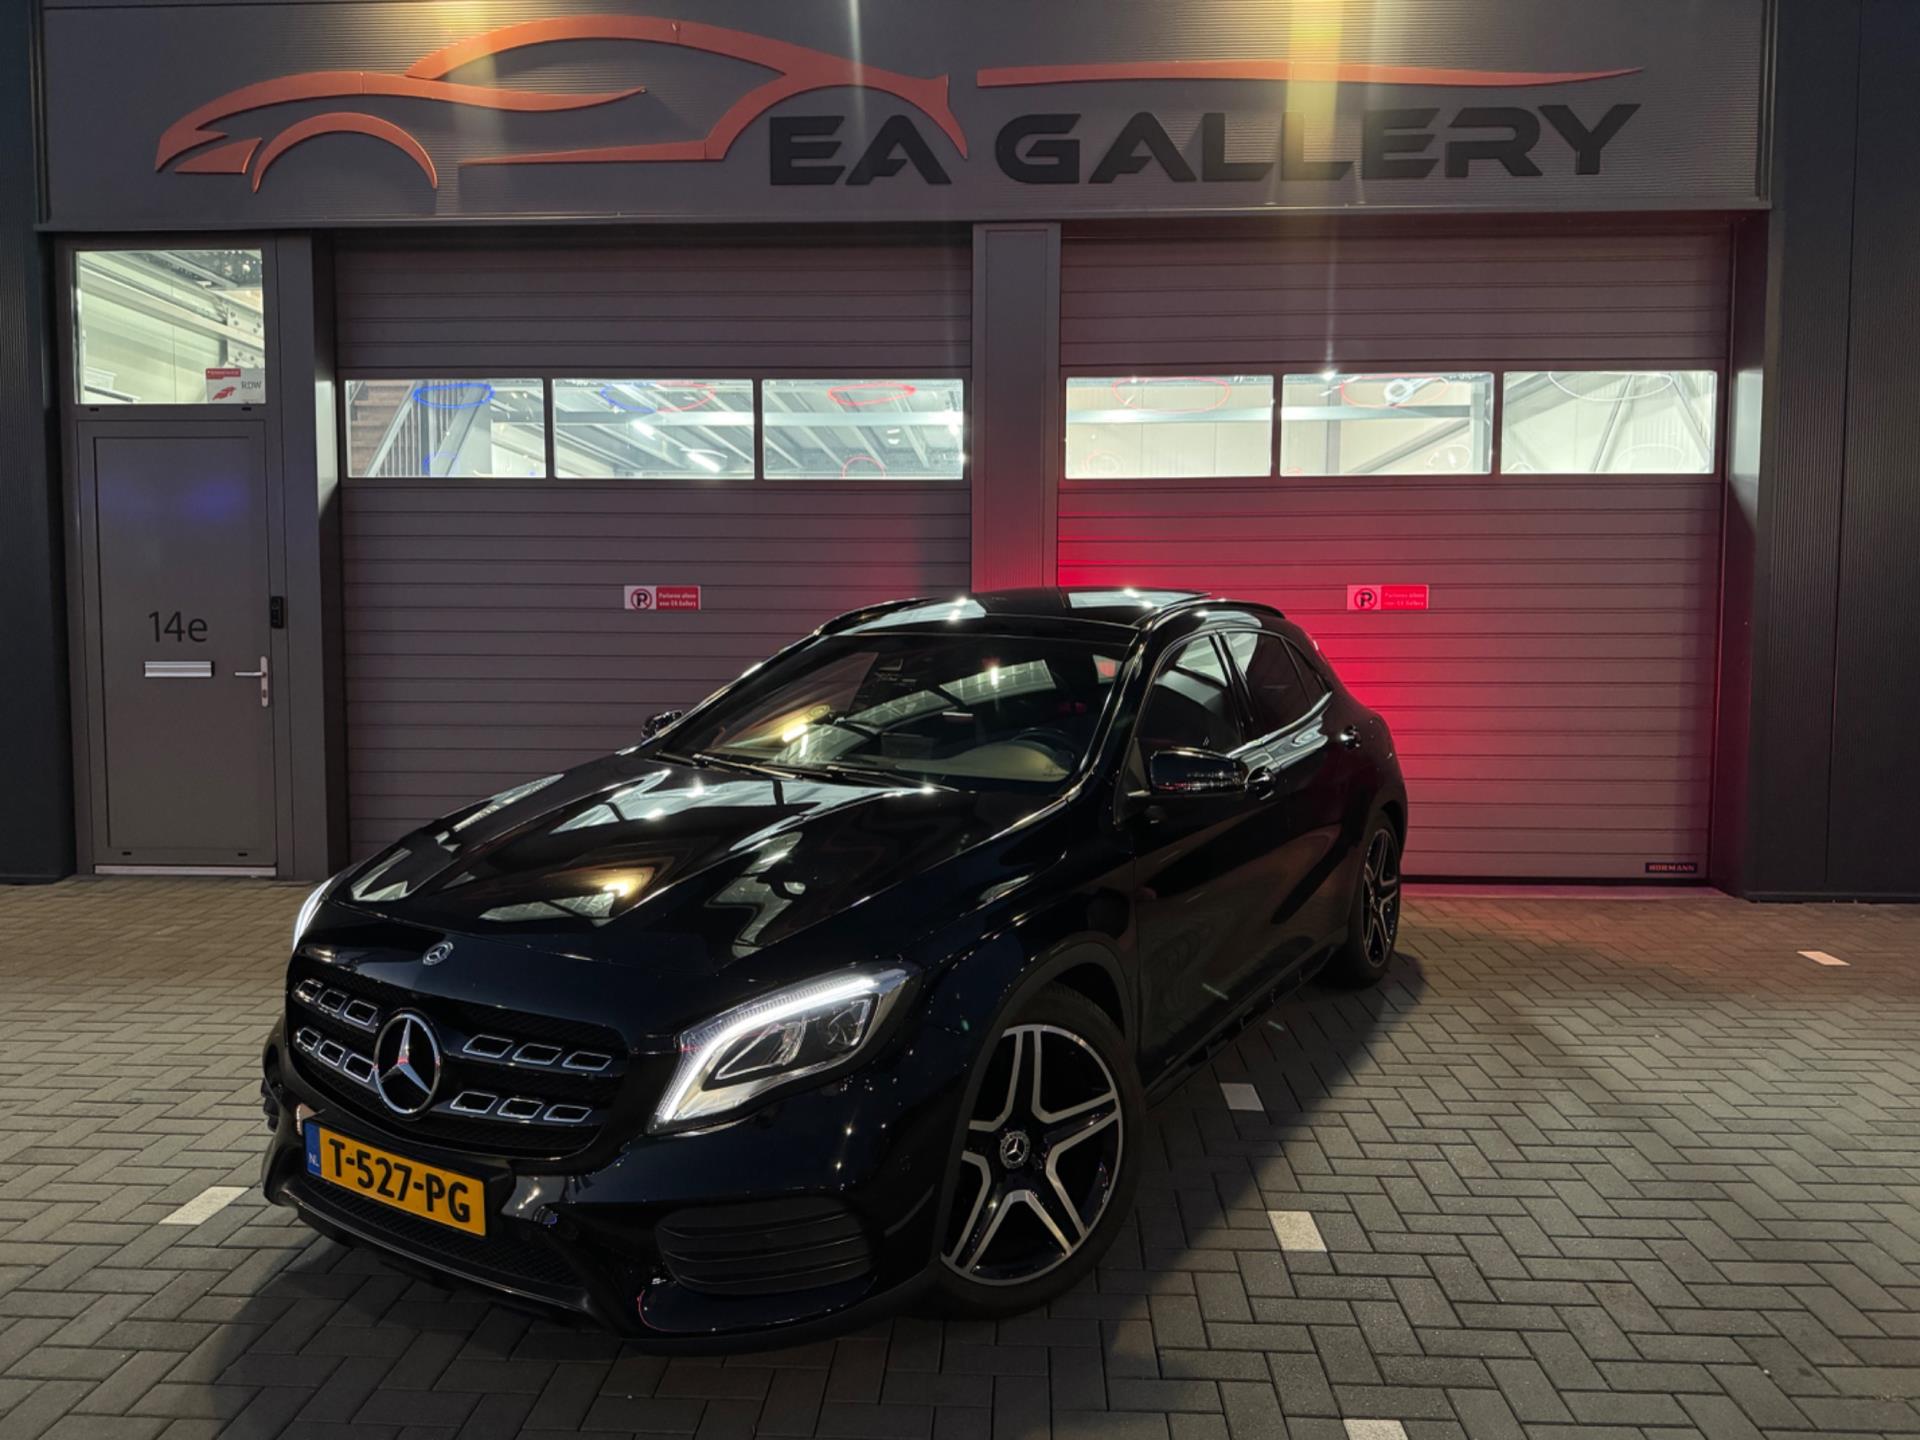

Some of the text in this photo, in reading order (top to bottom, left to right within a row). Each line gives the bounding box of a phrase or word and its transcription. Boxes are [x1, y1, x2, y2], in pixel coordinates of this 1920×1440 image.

[770, 104, 1642, 186] EA GALLERY
[149, 611, 208, 643] 14e
[308, 1152, 320, 1167] NL
[328, 1138, 471, 1223] T-527-PG
